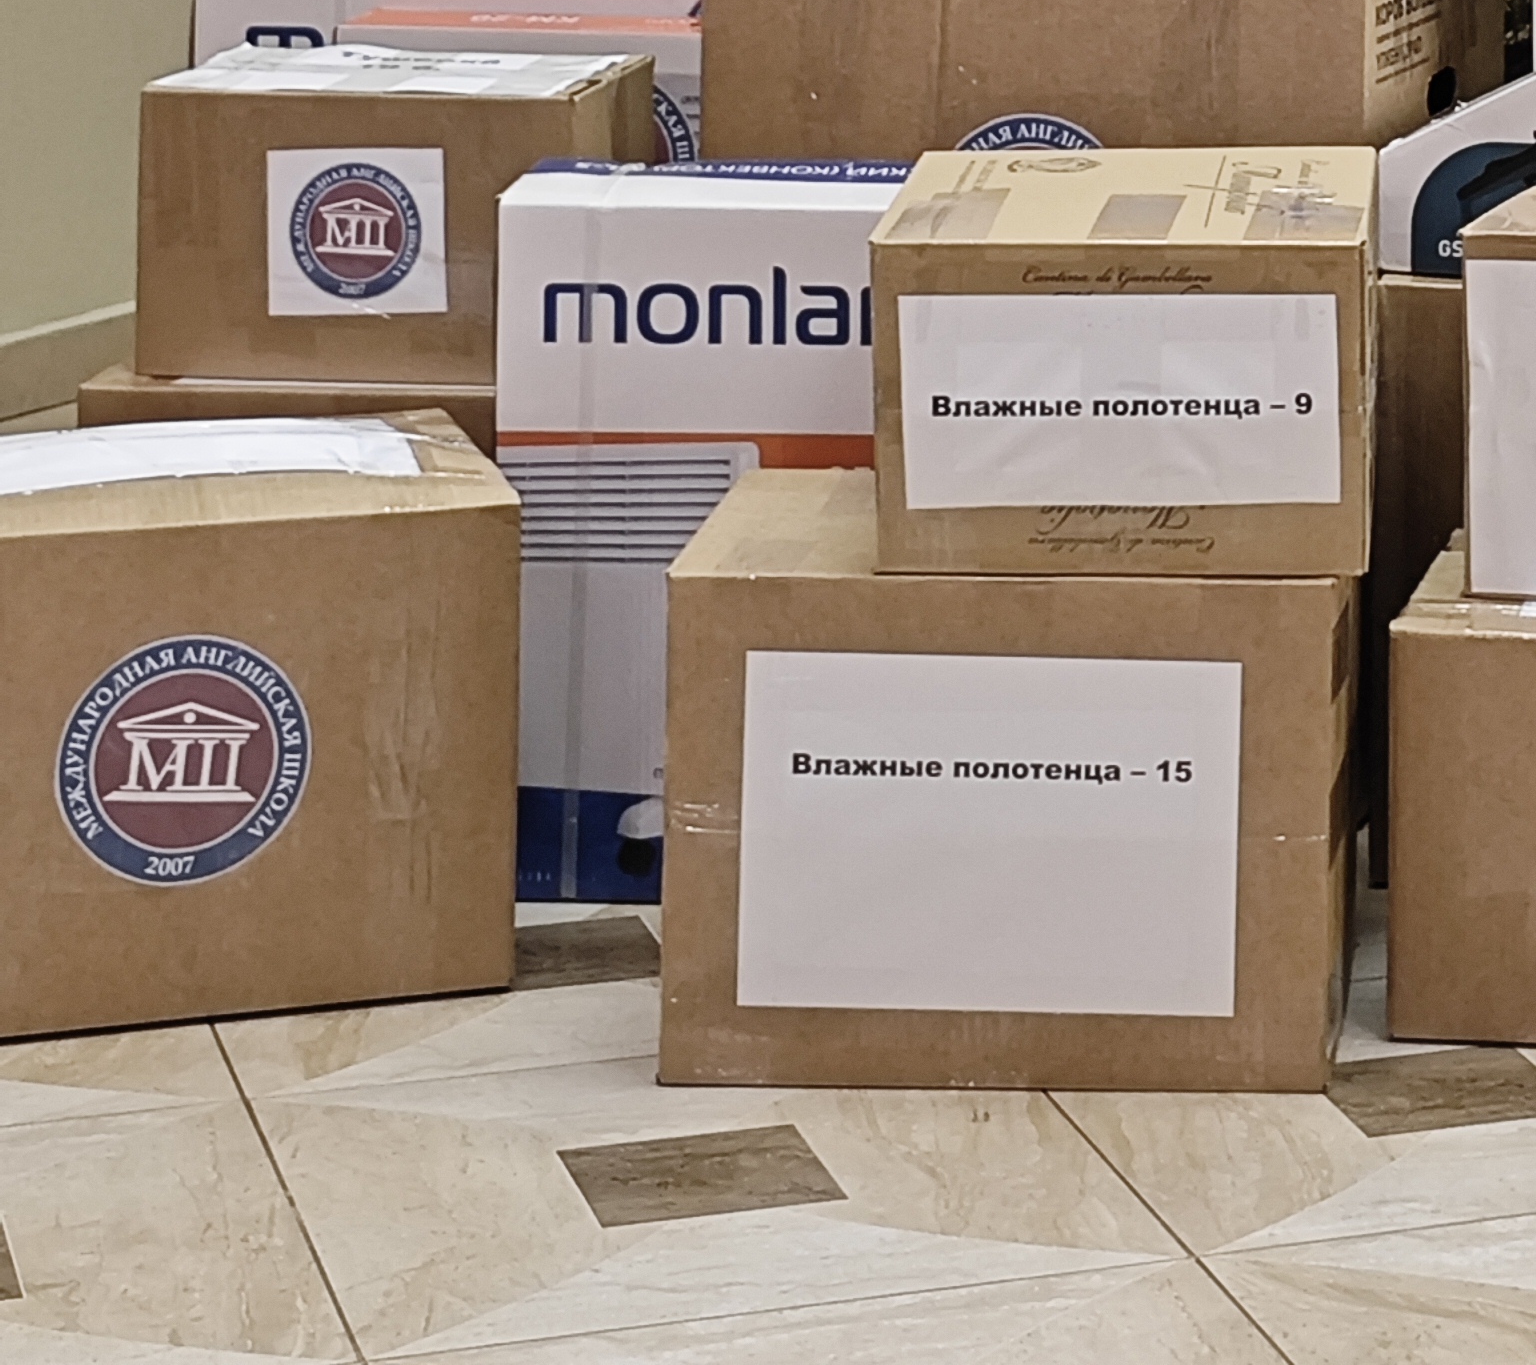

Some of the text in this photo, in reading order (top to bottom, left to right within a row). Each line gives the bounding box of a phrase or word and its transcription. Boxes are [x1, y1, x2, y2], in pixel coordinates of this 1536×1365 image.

[931, 394, 1082, 419] Влажные
[1092, 396, 1261, 421] полотенца
[1294, 392, 1313, 415] 9
[65, 645, 302, 840] МЕЖДУНАРОДНАЯ АНГЛИЙСКАЯ ШКОЛА
[791, 752, 943, 778] Влажные
[952, 758, 1122, 785] полотенца
[1156, 760, 1194, 784] 15
[144, 856, 195, 876] 2007
